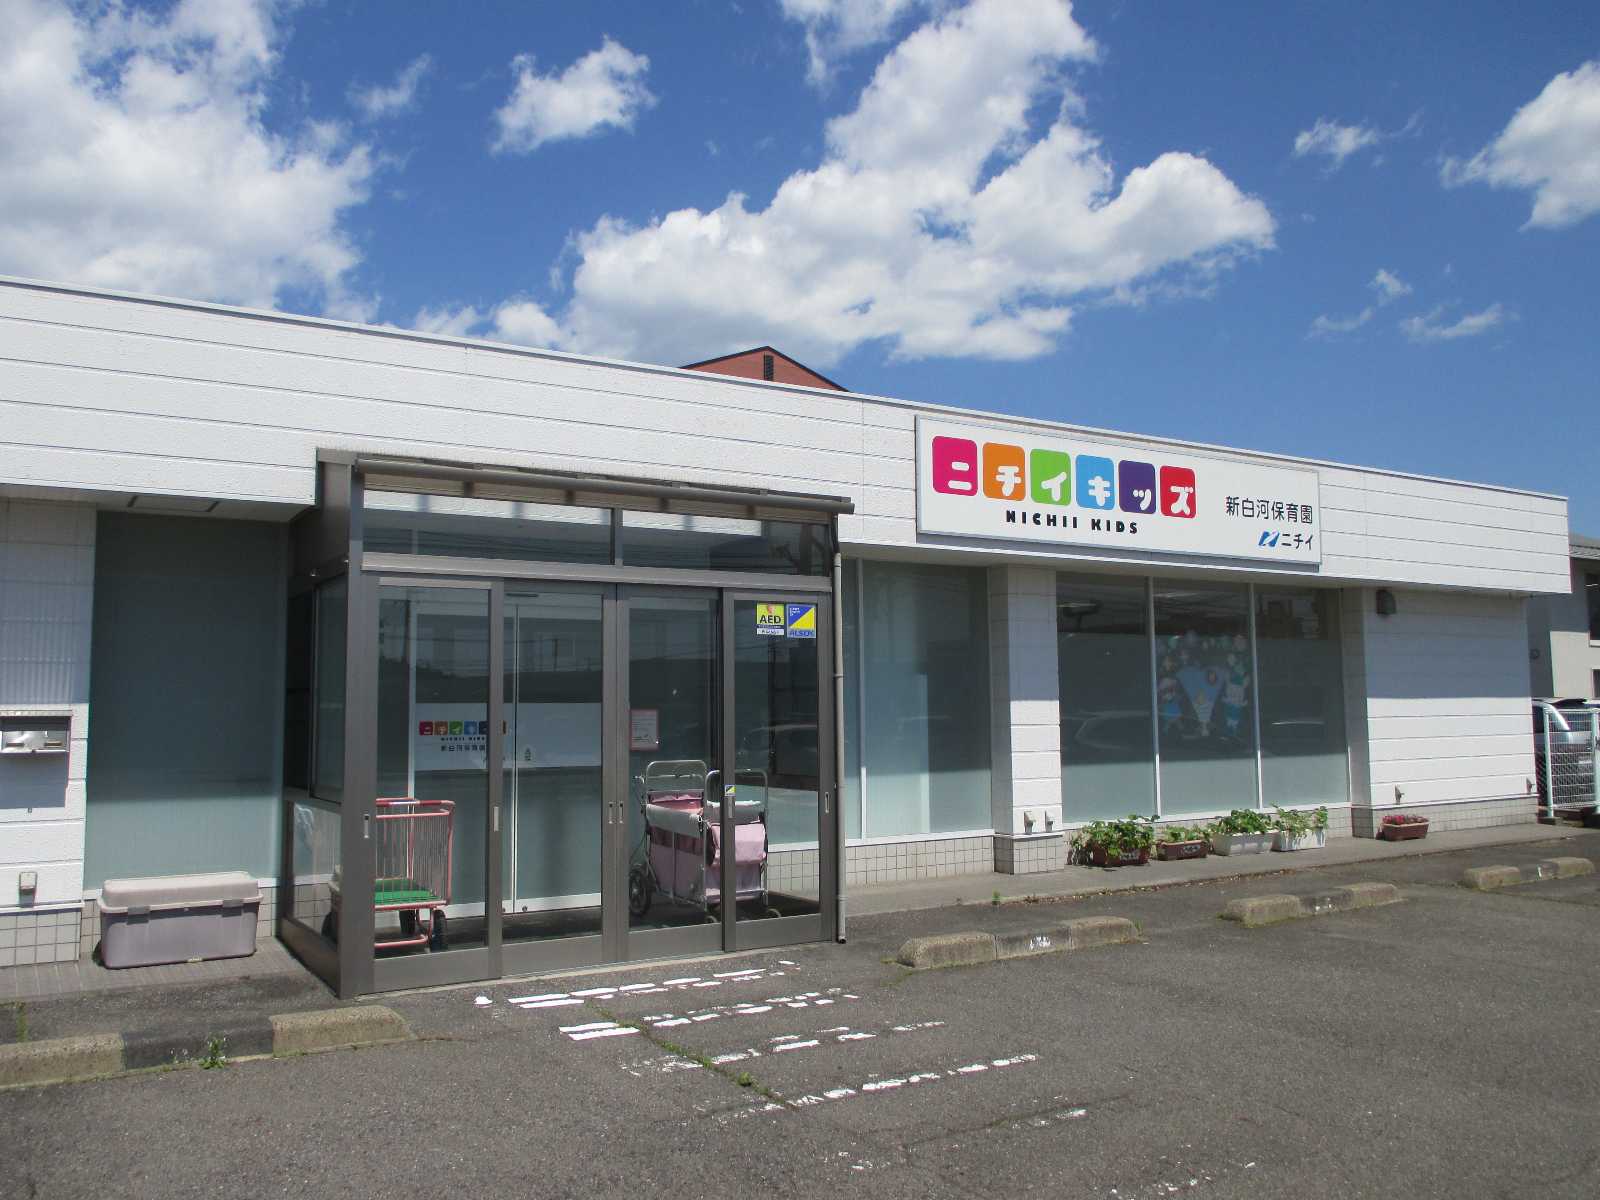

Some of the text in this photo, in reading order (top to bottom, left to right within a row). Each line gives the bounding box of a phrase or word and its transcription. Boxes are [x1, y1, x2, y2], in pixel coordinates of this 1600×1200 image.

[948, 461, 1194, 516] ニチイキッズ
[1225, 495, 1313, 524] 新白河保育園
[1006, 510, 1138, 534] NICHII KIDS
[1281, 532, 1314, 550] ニチイ
[760, 614, 782, 624] AED
